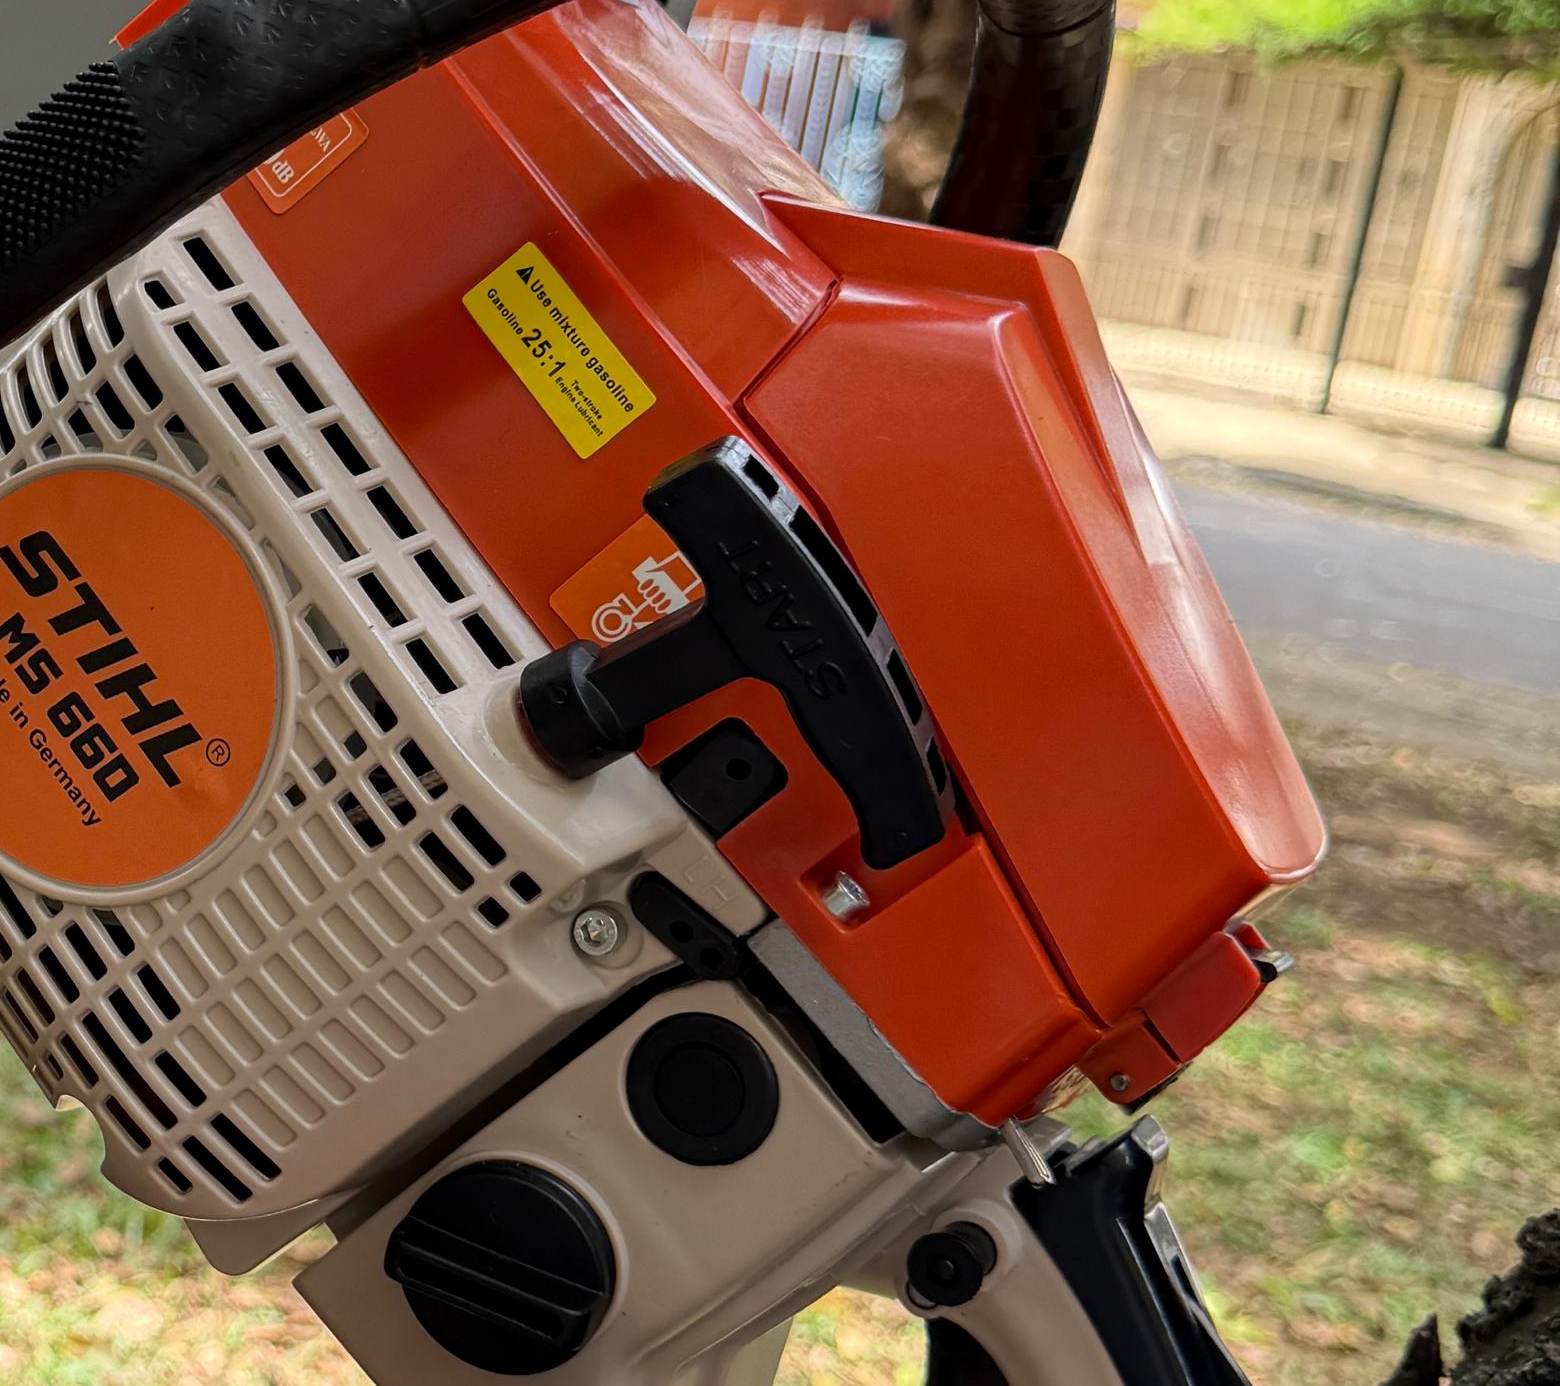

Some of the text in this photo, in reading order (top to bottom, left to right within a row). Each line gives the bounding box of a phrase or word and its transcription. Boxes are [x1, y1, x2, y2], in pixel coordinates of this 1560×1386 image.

[272, 160, 295, 184] dB
[487, 288, 566, 378] Gasoline 25:1
[529, 279, 634, 413] Use mixture gasoline
[717, 539, 847, 700] START
[9, 701, 29, 729] in
[28, 728, 102, 827] Germany
[46, 691, 140, 803] 660
